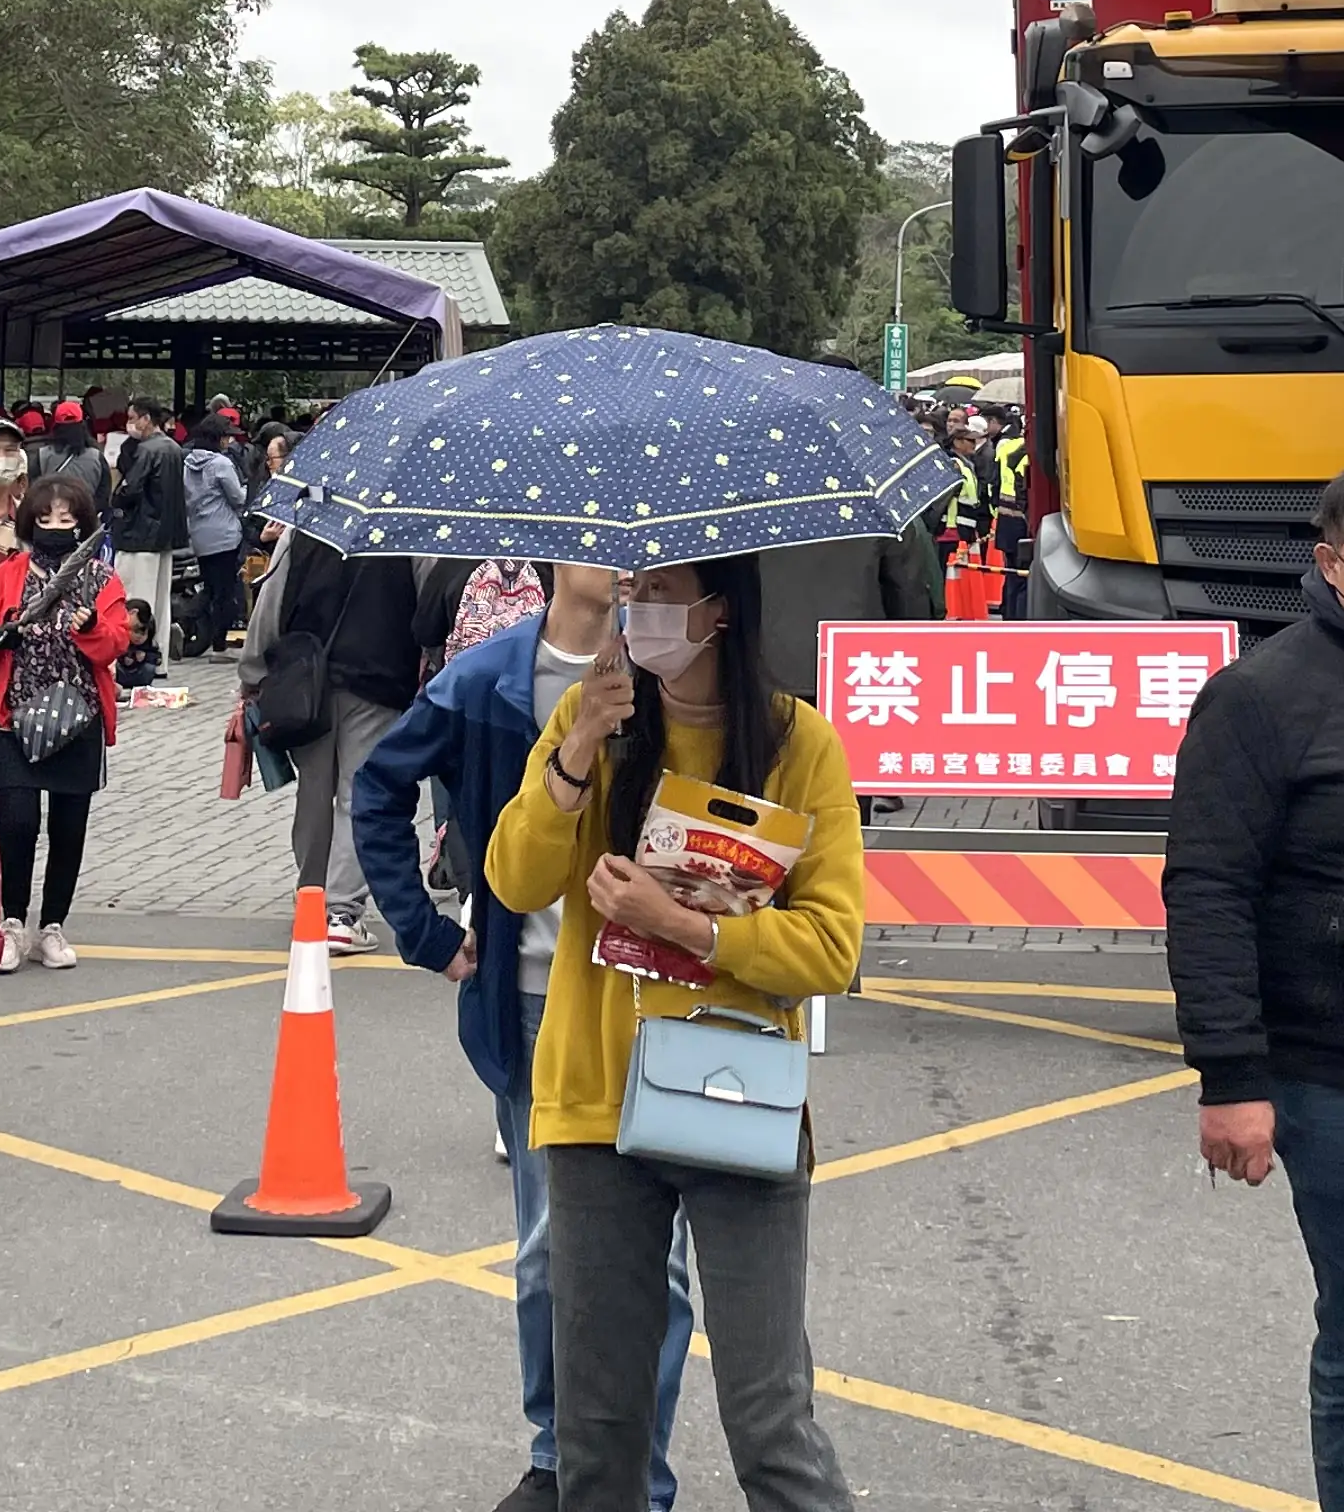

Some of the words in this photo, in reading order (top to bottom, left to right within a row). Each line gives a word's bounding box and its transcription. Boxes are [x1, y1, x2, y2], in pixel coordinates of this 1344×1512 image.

[844, 650, 1210, 728] 禁止停車
[878, 752, 1131, 777] 紫南宮管理委員會
